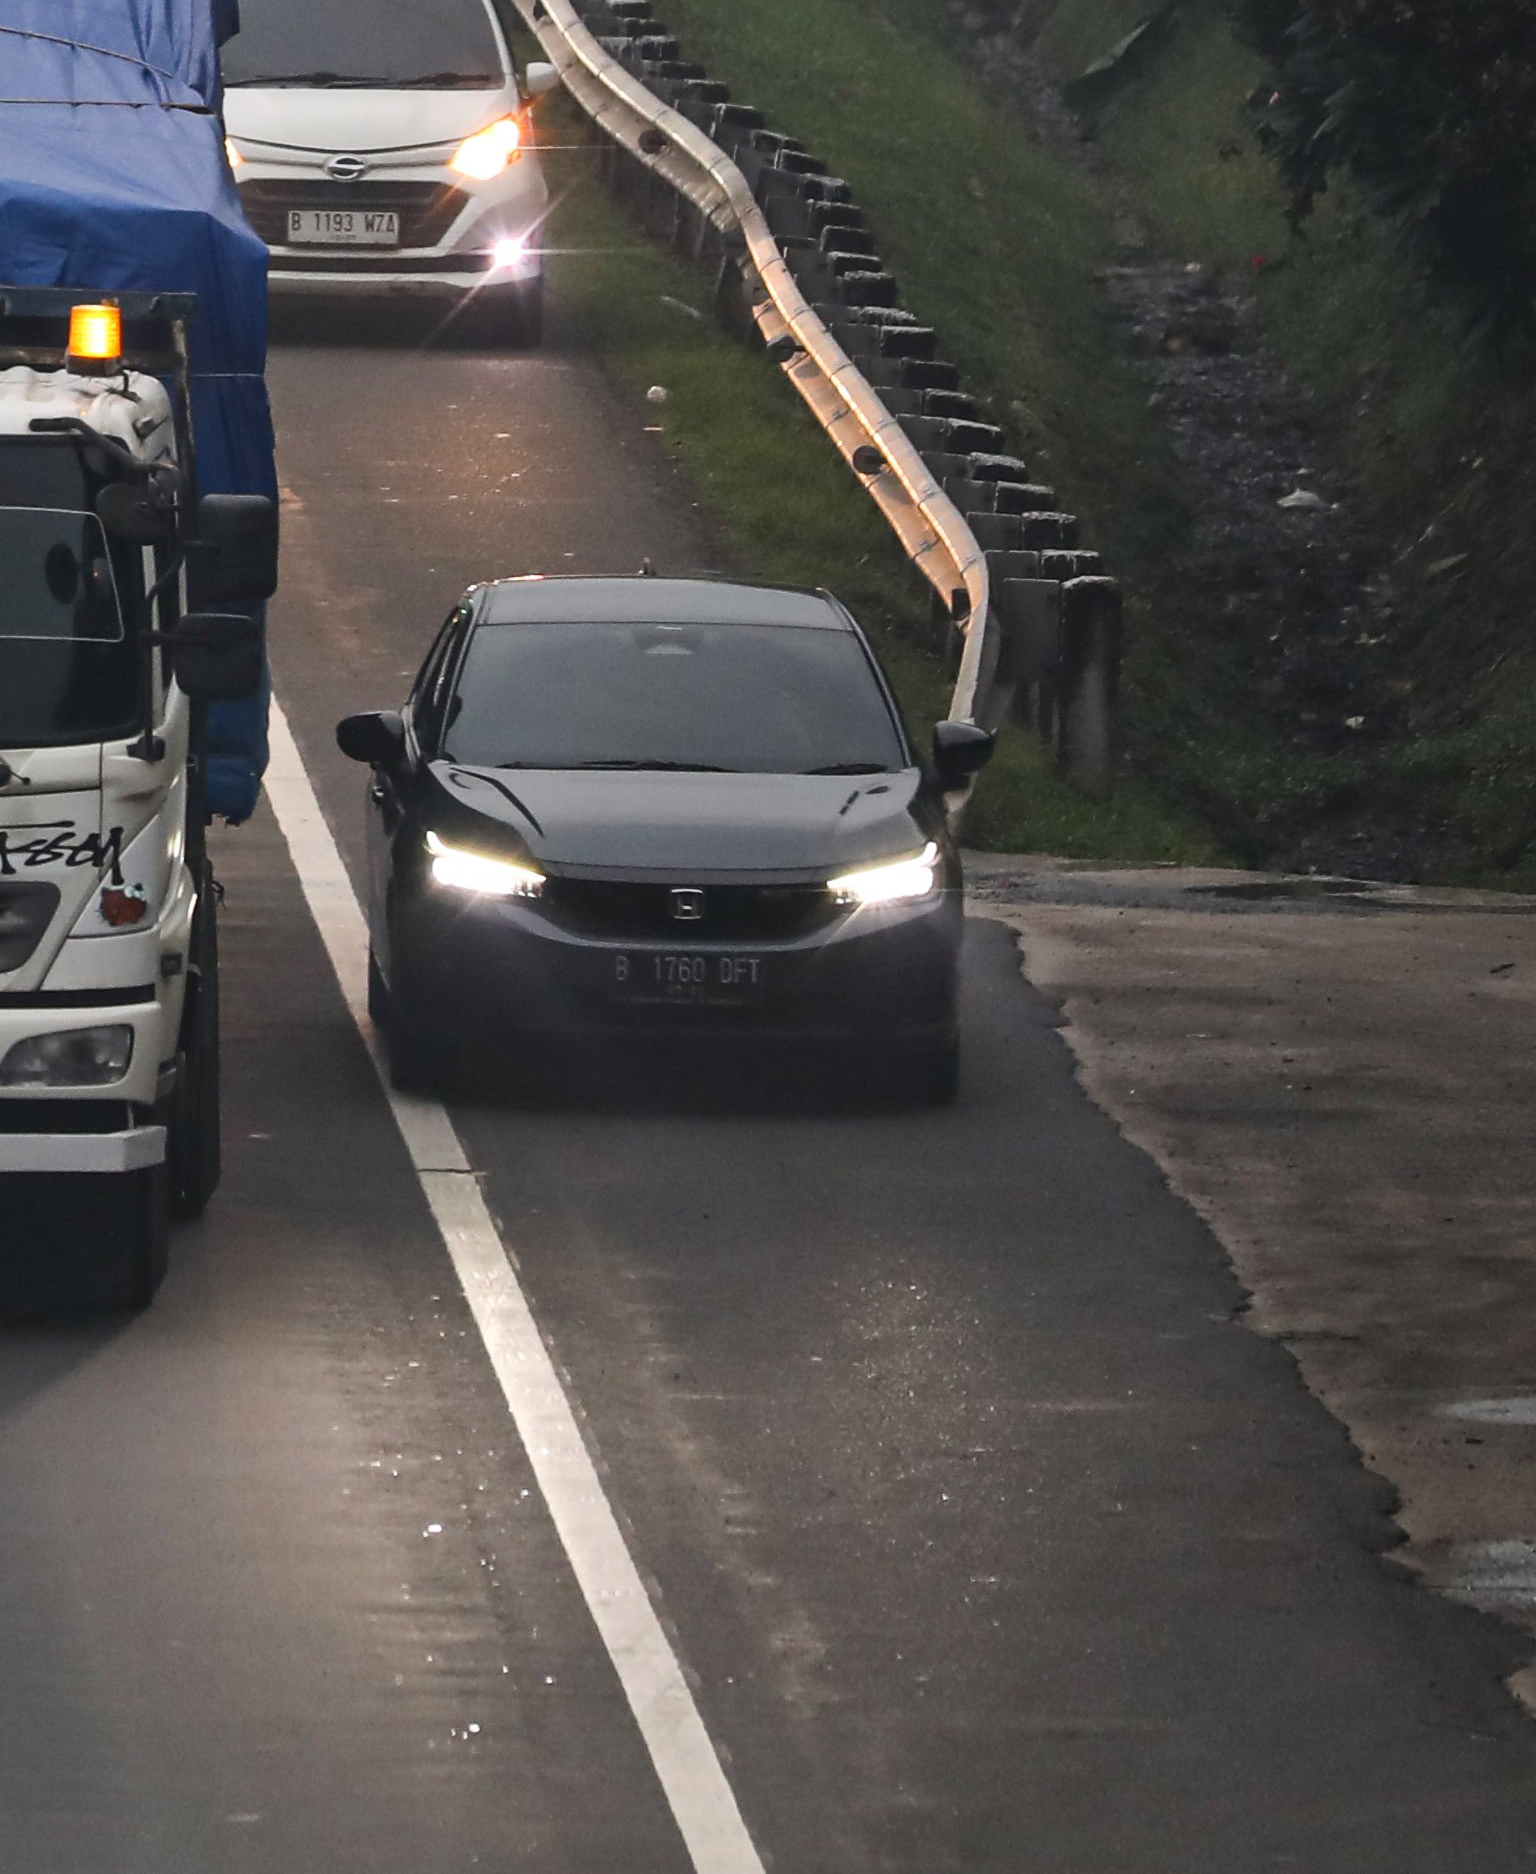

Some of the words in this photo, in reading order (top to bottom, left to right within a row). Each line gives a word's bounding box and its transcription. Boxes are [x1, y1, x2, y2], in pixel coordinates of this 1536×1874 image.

[291, 212, 301, 231] B
[314, 213, 353, 232] 1193
[615, 955, 629, 981] B
[653, 957, 705, 982] 1760
[720, 958, 760, 983] DFT
